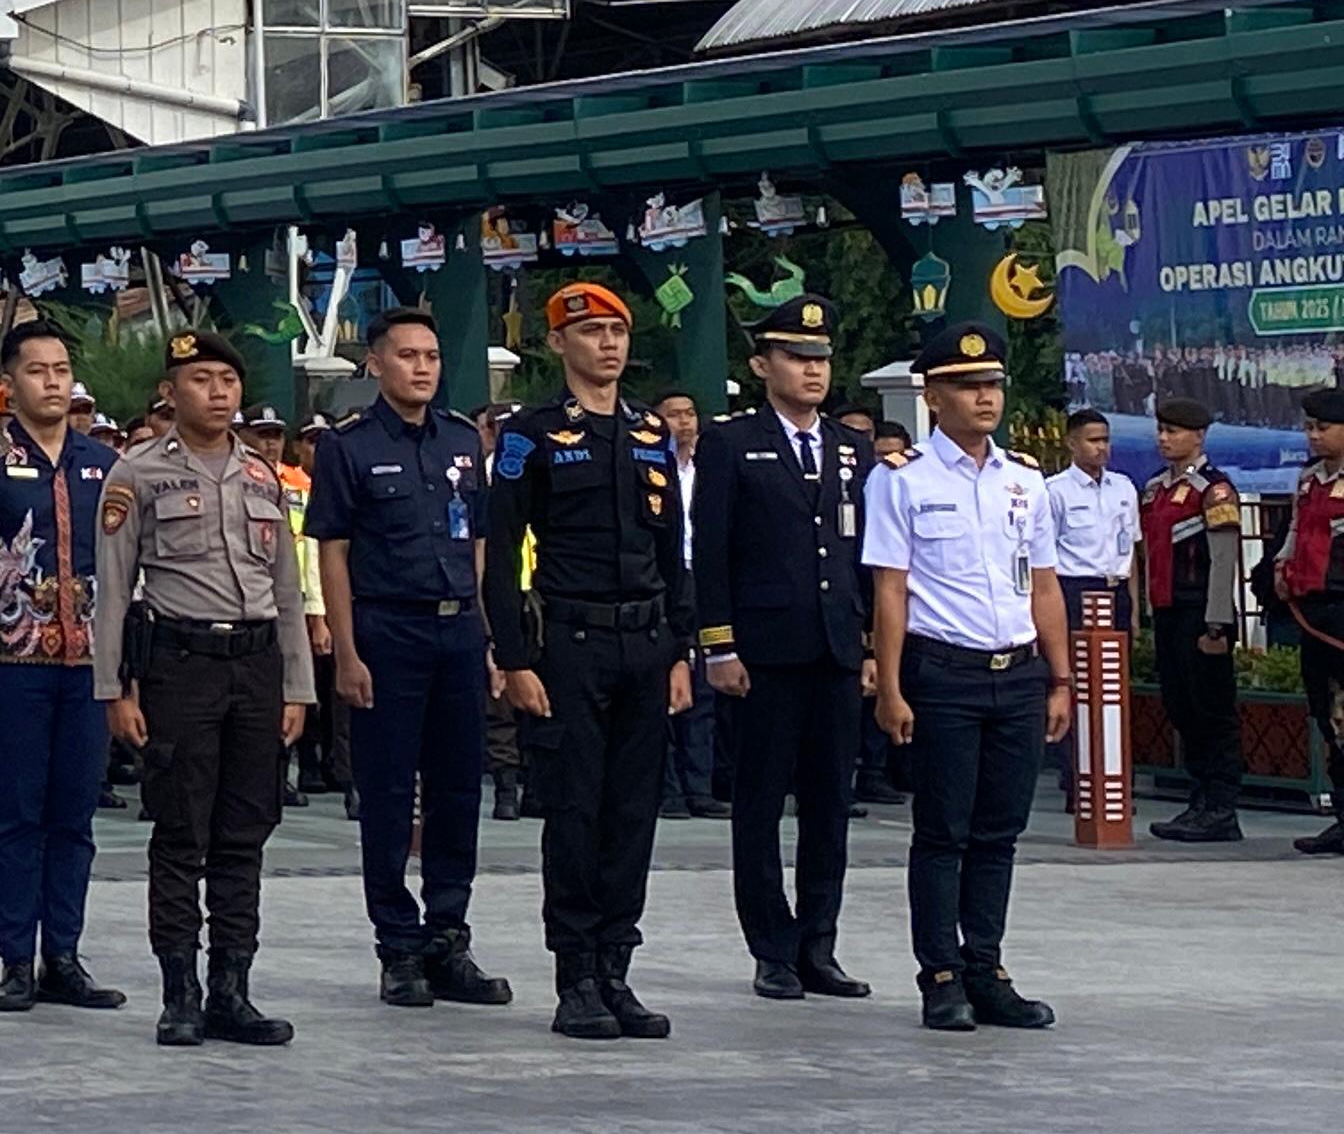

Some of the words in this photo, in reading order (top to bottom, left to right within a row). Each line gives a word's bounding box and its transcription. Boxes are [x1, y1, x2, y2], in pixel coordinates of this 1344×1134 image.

[1192, 197, 1249, 228] APEL
[1253, 189, 1333, 222] GELAR
[1252, 227, 1311, 251] DALAM
[1159, 260, 1253, 293] OPERASI
[1258, 254, 1344, 285] ANGKU
[1300, 298, 1329, 319] 2025
